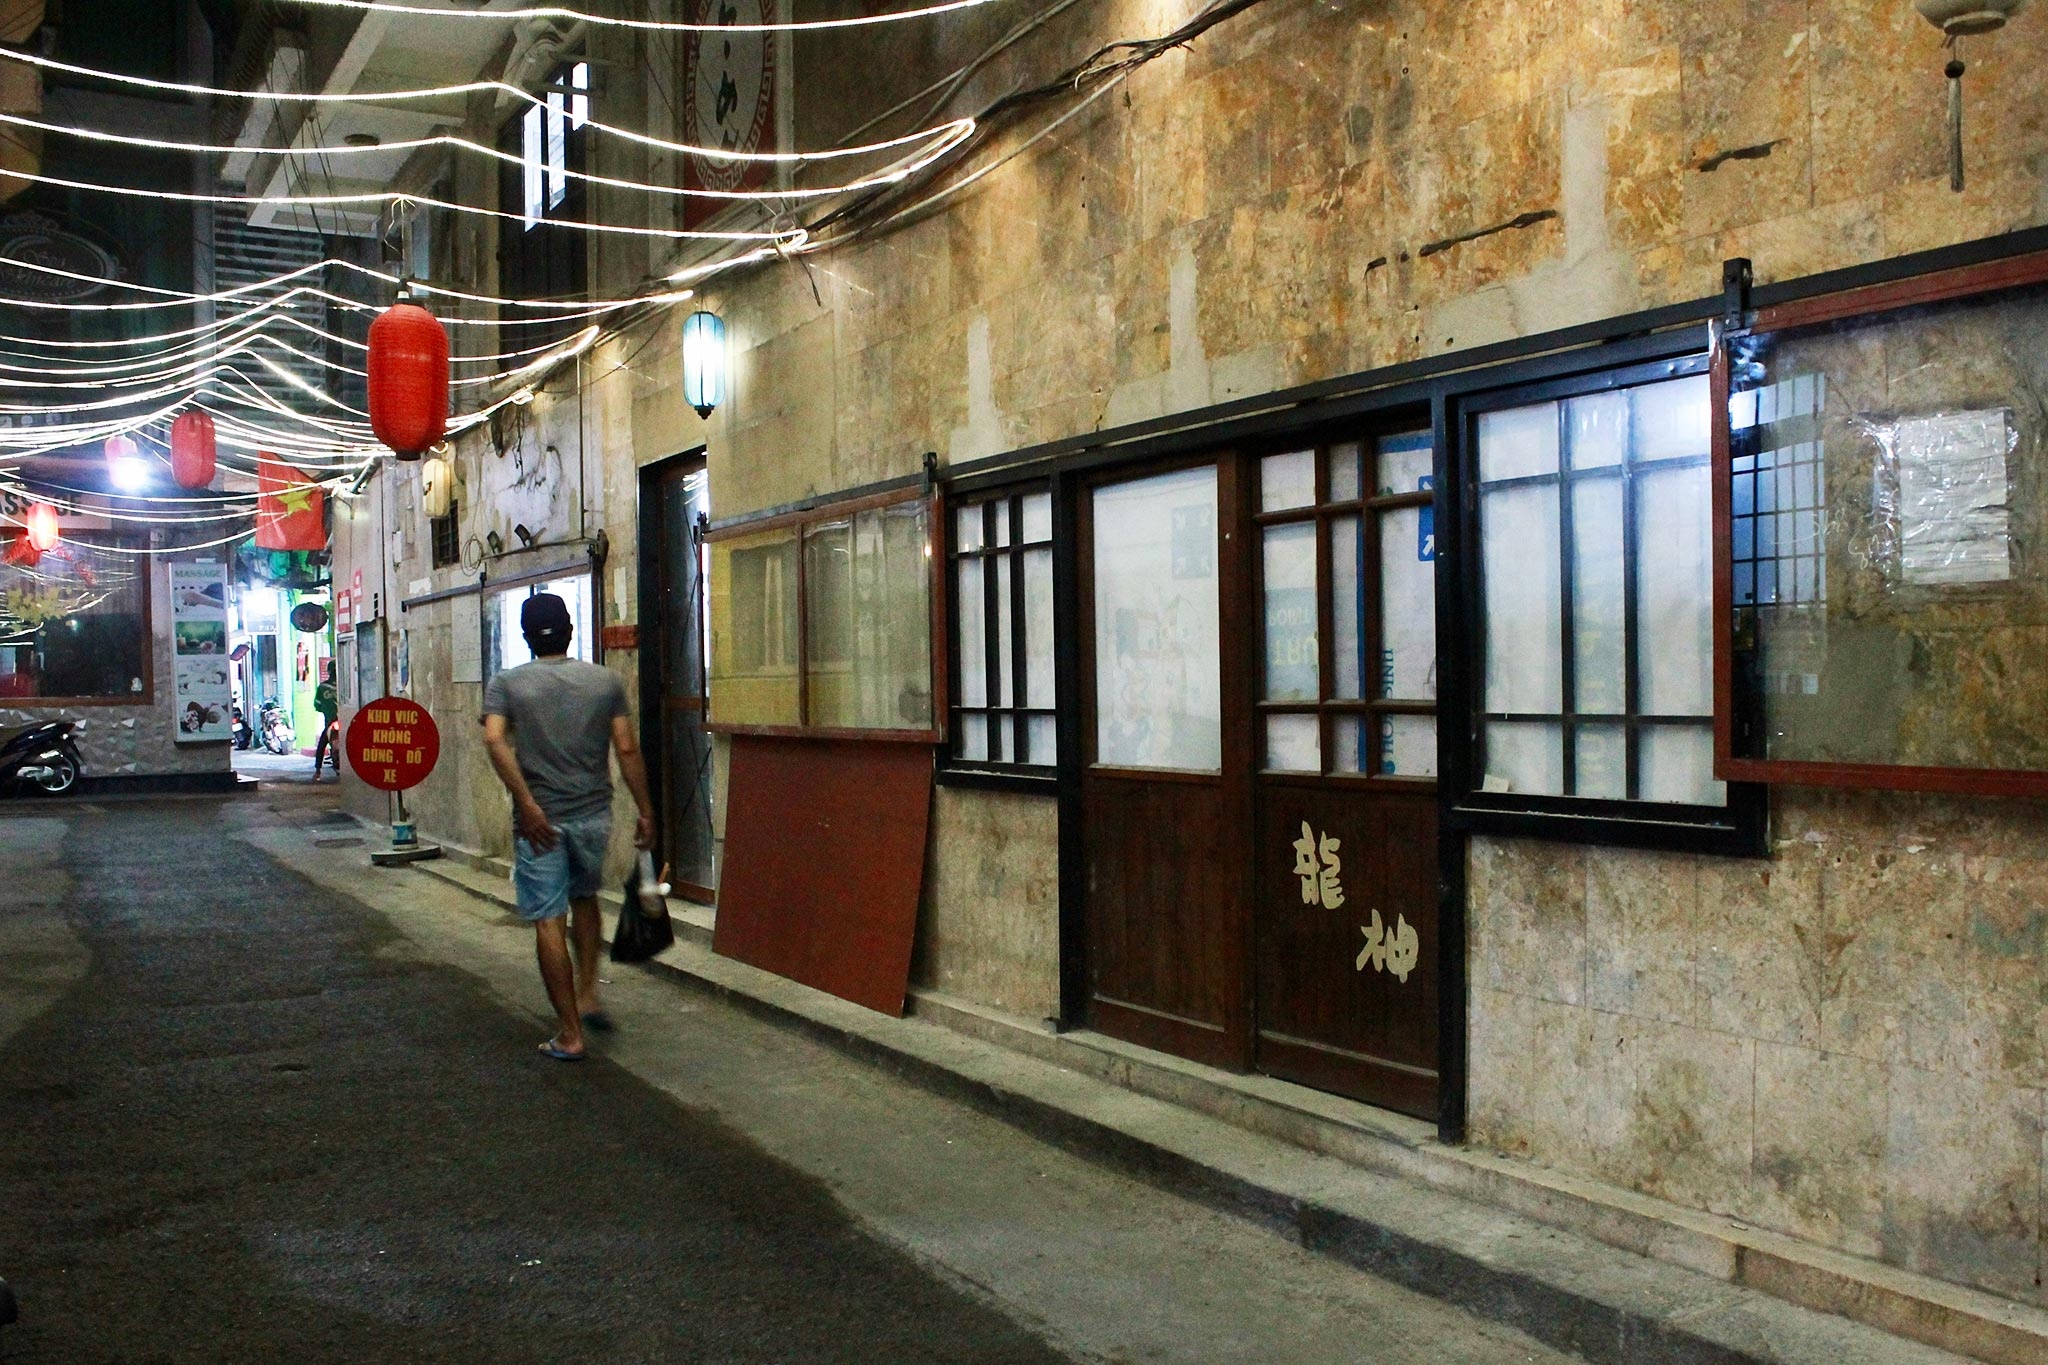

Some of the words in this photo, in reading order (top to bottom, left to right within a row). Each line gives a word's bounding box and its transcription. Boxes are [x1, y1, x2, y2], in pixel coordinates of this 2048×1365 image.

[367, 709, 391, 724] KHU
[373, 726, 411, 745] KHÔNG
[383, 769, 397, 783] XE
